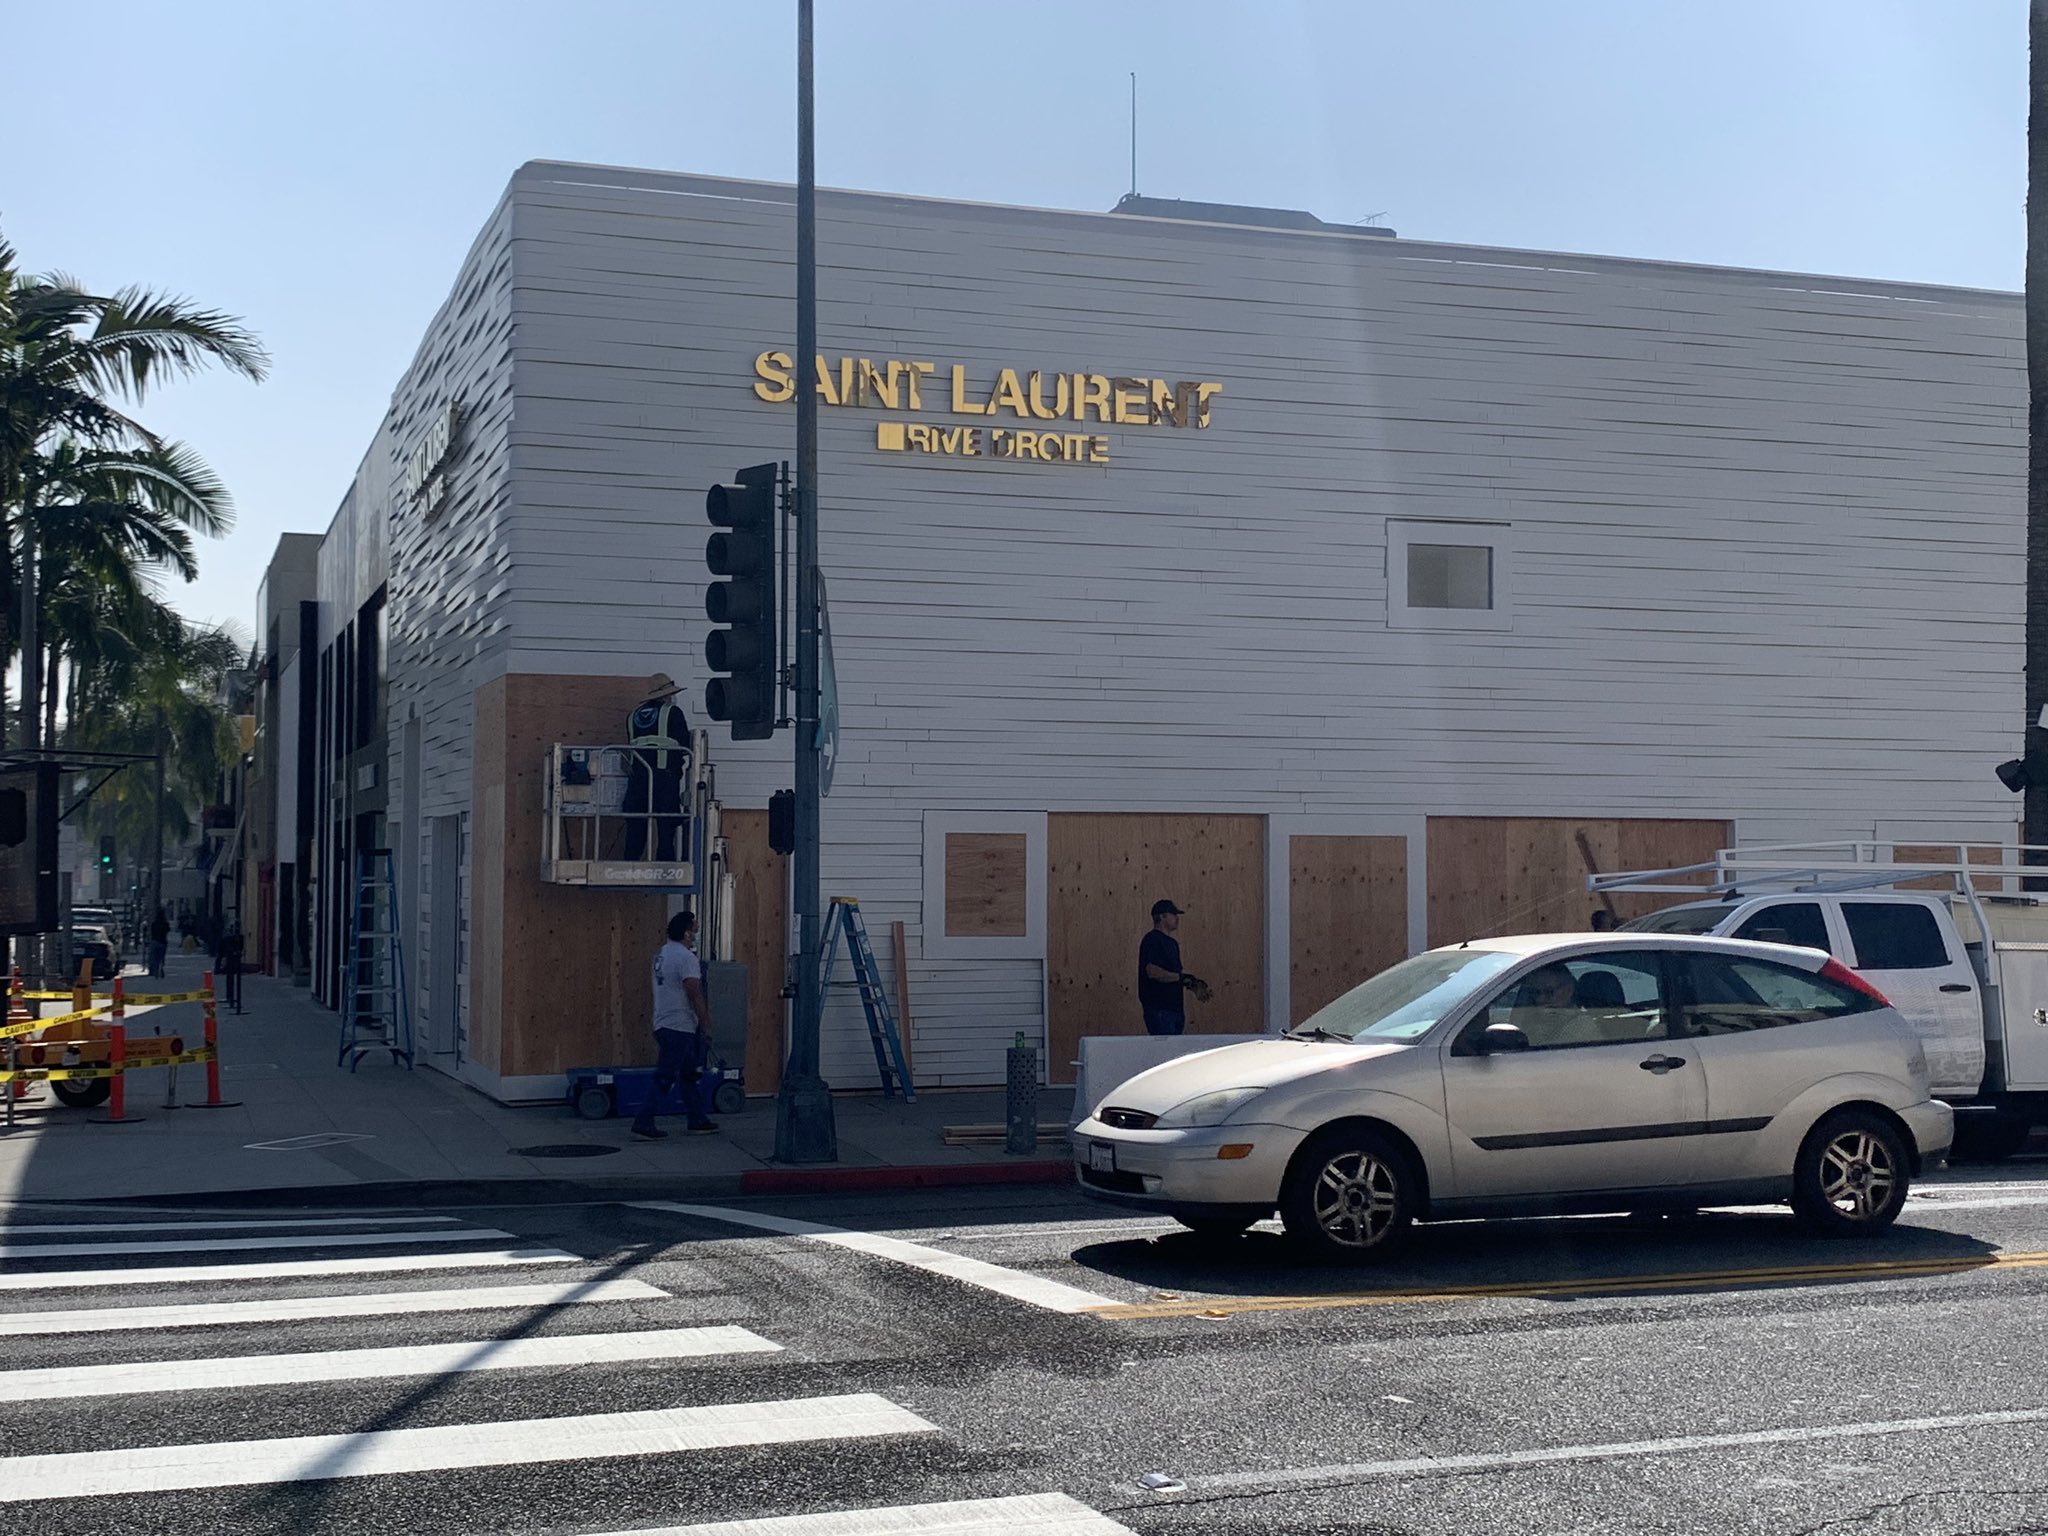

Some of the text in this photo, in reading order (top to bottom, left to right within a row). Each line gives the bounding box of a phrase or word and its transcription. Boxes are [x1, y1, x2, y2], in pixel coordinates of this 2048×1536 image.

[753, 351, 1223, 429] SAINT LAURENT
[908, 423, 1110, 463] RIVE DROITE
[5, 1013, 83, 1035] CAUTION CAUTION
